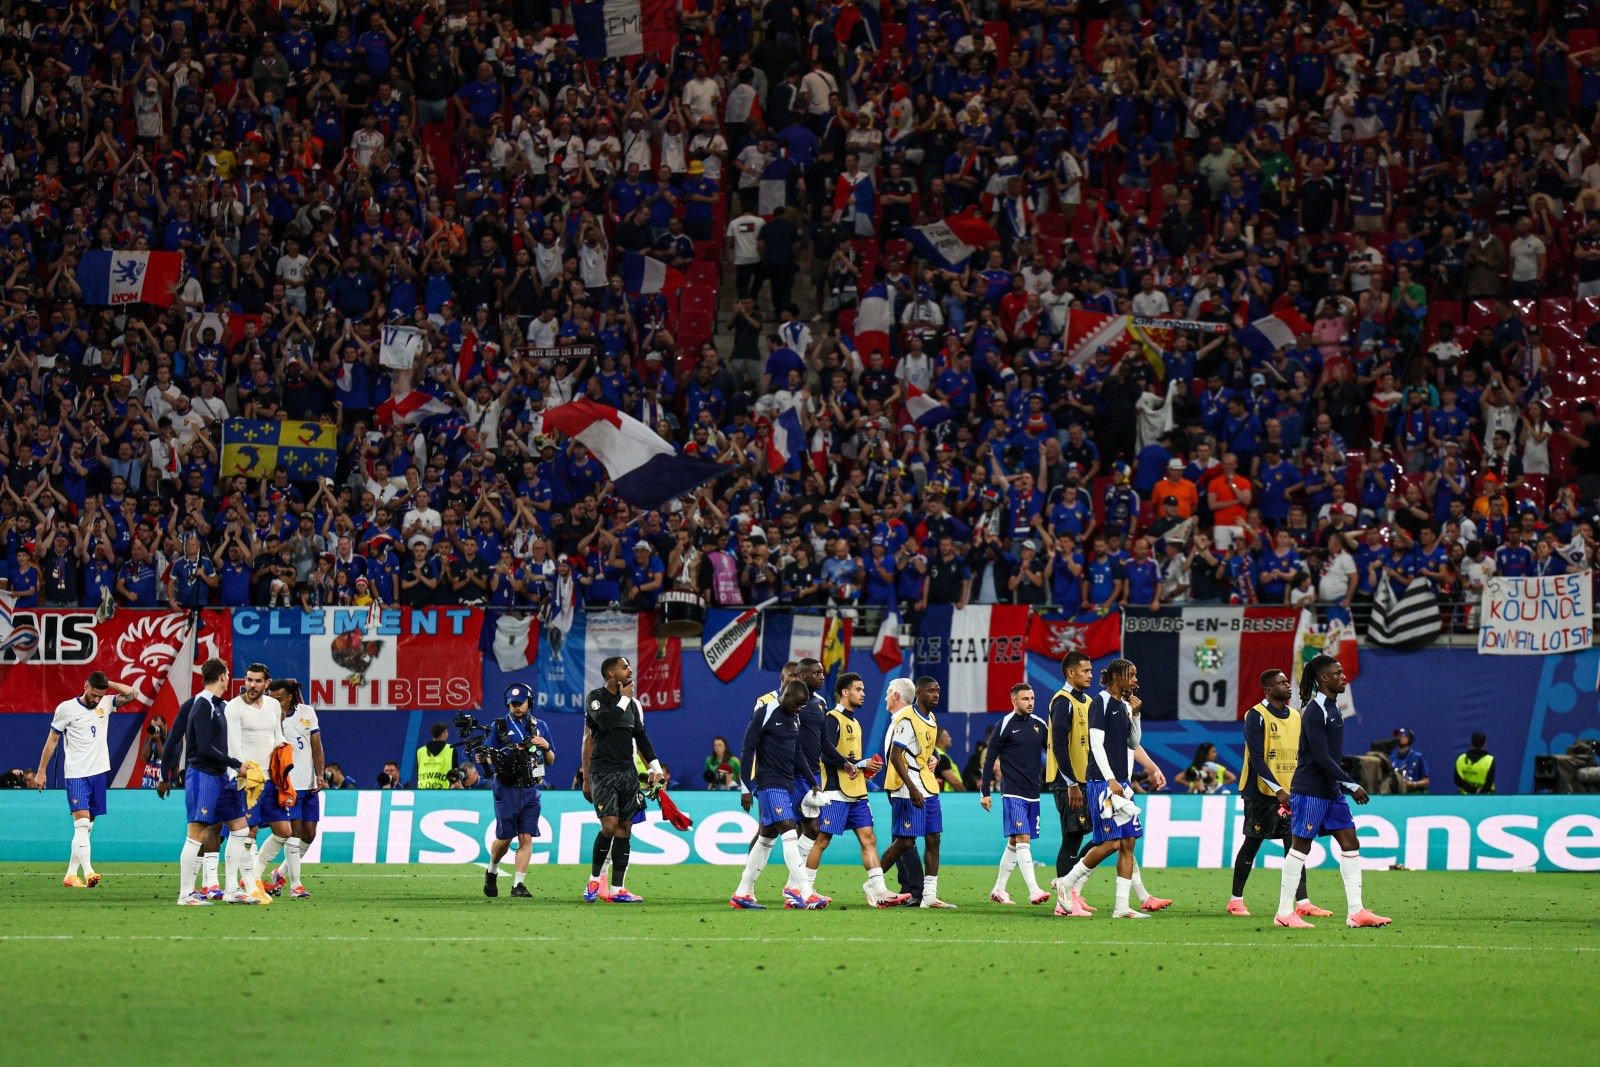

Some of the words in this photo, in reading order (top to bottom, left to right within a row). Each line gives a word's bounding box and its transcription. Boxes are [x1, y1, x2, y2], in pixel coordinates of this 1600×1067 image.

[111, 292, 138, 304] LYON
[383, 326, 399, 346] 17
[1508, 575, 1580, 598] JULES
[233, 609, 471, 636] CLEMENT
[1126, 616, 1296, 633] BOURG-EN-BRESSE
[915, 636, 941, 664] LE
[948, 635, 1023, 664] HAVRE
[1189, 679, 1228, 708] 01
[91, 725, 97, 738] 9
[296, 735, 304, 751] 5
[417, 771, 448, 782] TEWARD
